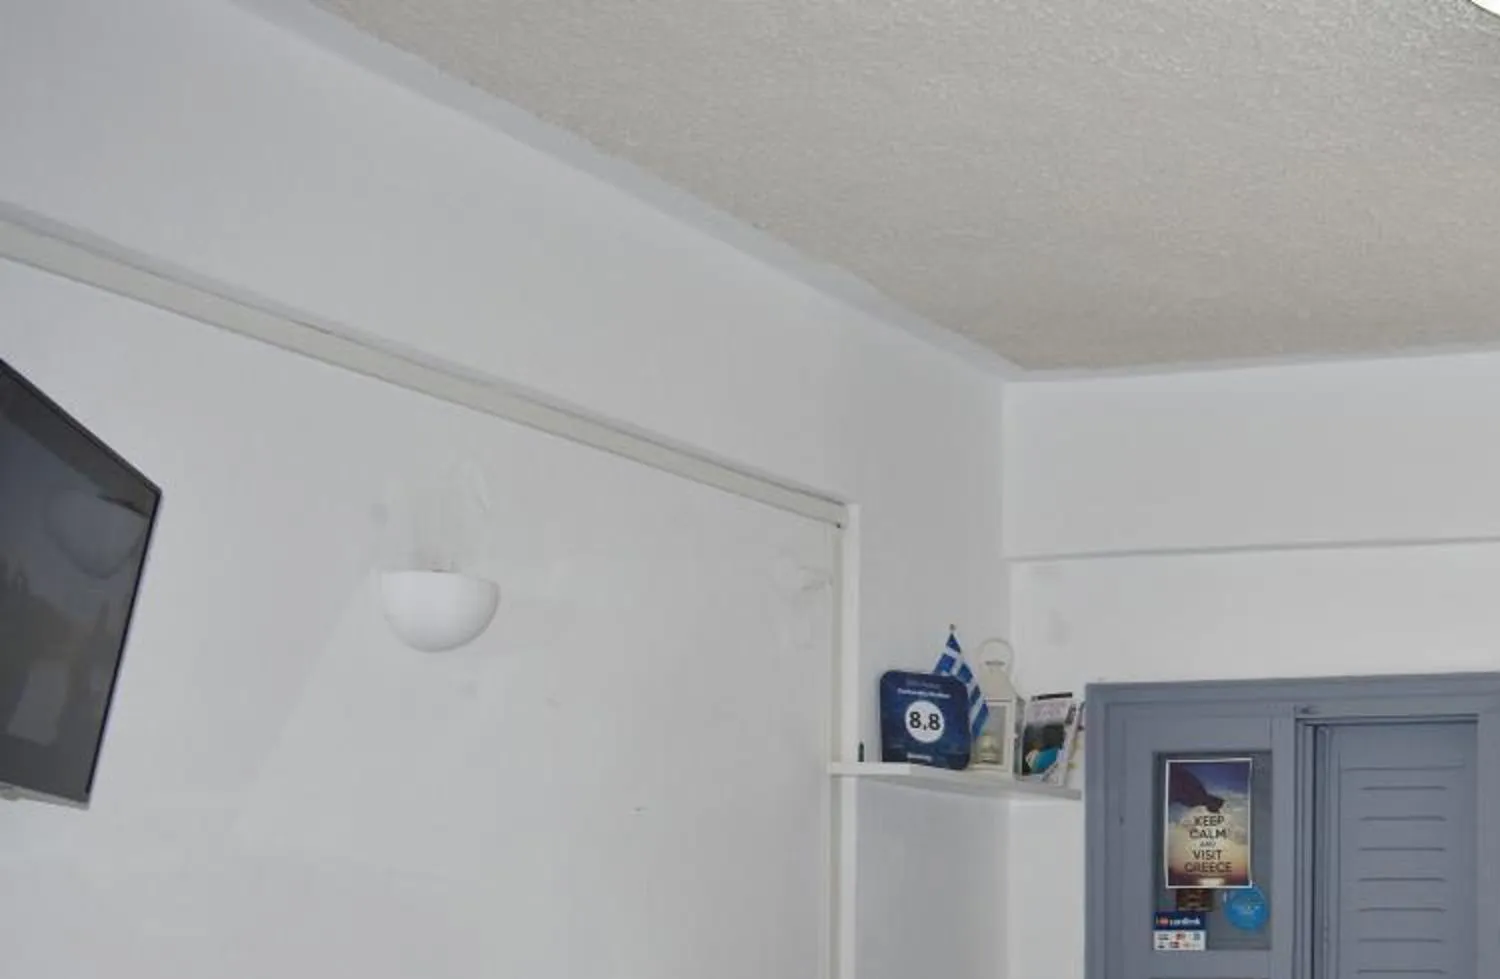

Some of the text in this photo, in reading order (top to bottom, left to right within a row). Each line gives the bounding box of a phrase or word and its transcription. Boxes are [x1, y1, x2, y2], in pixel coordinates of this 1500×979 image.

[1193, 815, 1225, 827] KEEP
[1189, 828, 1228, 839] CALM
[1192, 849, 1222, 860] VISIT
[1184, 861, 1233, 873] GREECE
